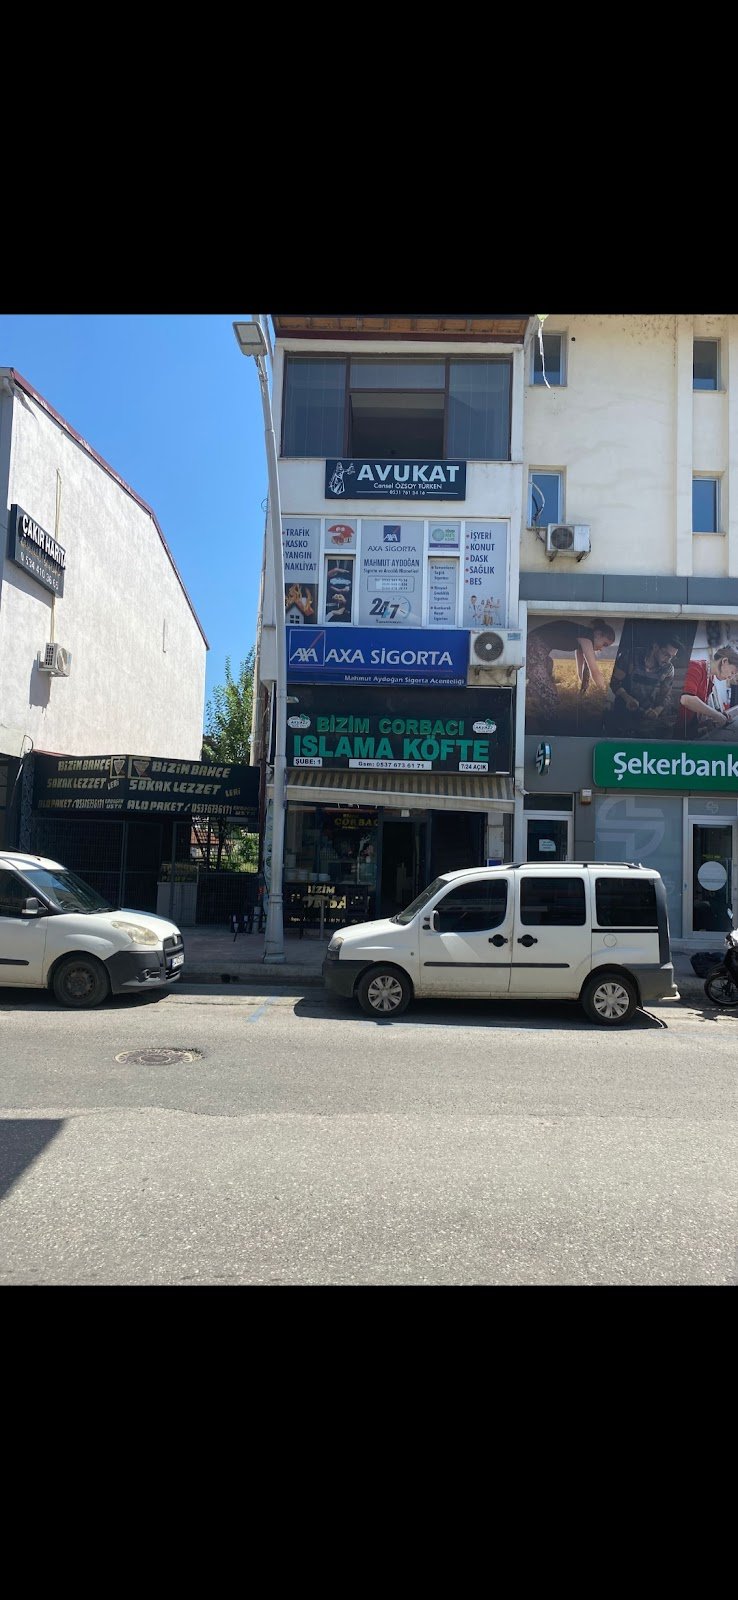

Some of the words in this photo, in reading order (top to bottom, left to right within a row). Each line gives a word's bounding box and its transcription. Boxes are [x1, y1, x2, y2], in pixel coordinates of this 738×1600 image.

[357, 464, 460, 482] AVUKAT
[395, 482, 416, 490] ÖZSOY
[418, 482, 442, 490] TÜRKEN
[22, 514, 45, 550] ÇAKIR
[286, 527, 310, 537] TRAFİK
[470, 530, 492, 542] İŞYERİ
[285, 539, 309, 548] KASKO
[470, 543, 495, 551] KONUT
[285, 551, 312, 560] YANGIN
[470, 554, 489, 563] DASK
[284, 560, 317, 571] NAKLİYAT
[363, 558, 390, 567] MAHMUT
[391, 557, 420, 567] AYDOĞAN
[469, 563, 495, 574] SAĞLIK
[470, 577, 482, 586] BES
[289, 647, 318, 662] AXA
[325, 648, 365, 663] AXA
[371, 647, 453, 666] SİGORTA
[373, 676, 402, 684] Aydoğan
[404, 676, 429, 684] Sigorta
[430, 677, 465, 685] Acenteliği
[316, 714, 370, 733] BİZİM
[293, 735, 394, 759] ISLAMA
[403, 734, 490, 762] KÖFTE
[295, 758, 317, 766] ŞUBE:
[613, 751, 738, 781] Şekerbank
[72, 778, 107, 789] LEZZET
[128, 779, 172, 793] SOKAK
[172, 781, 222, 796] LEZZET
[127, 799, 149, 811] ALO
[149, 801, 184, 812] PAKET
